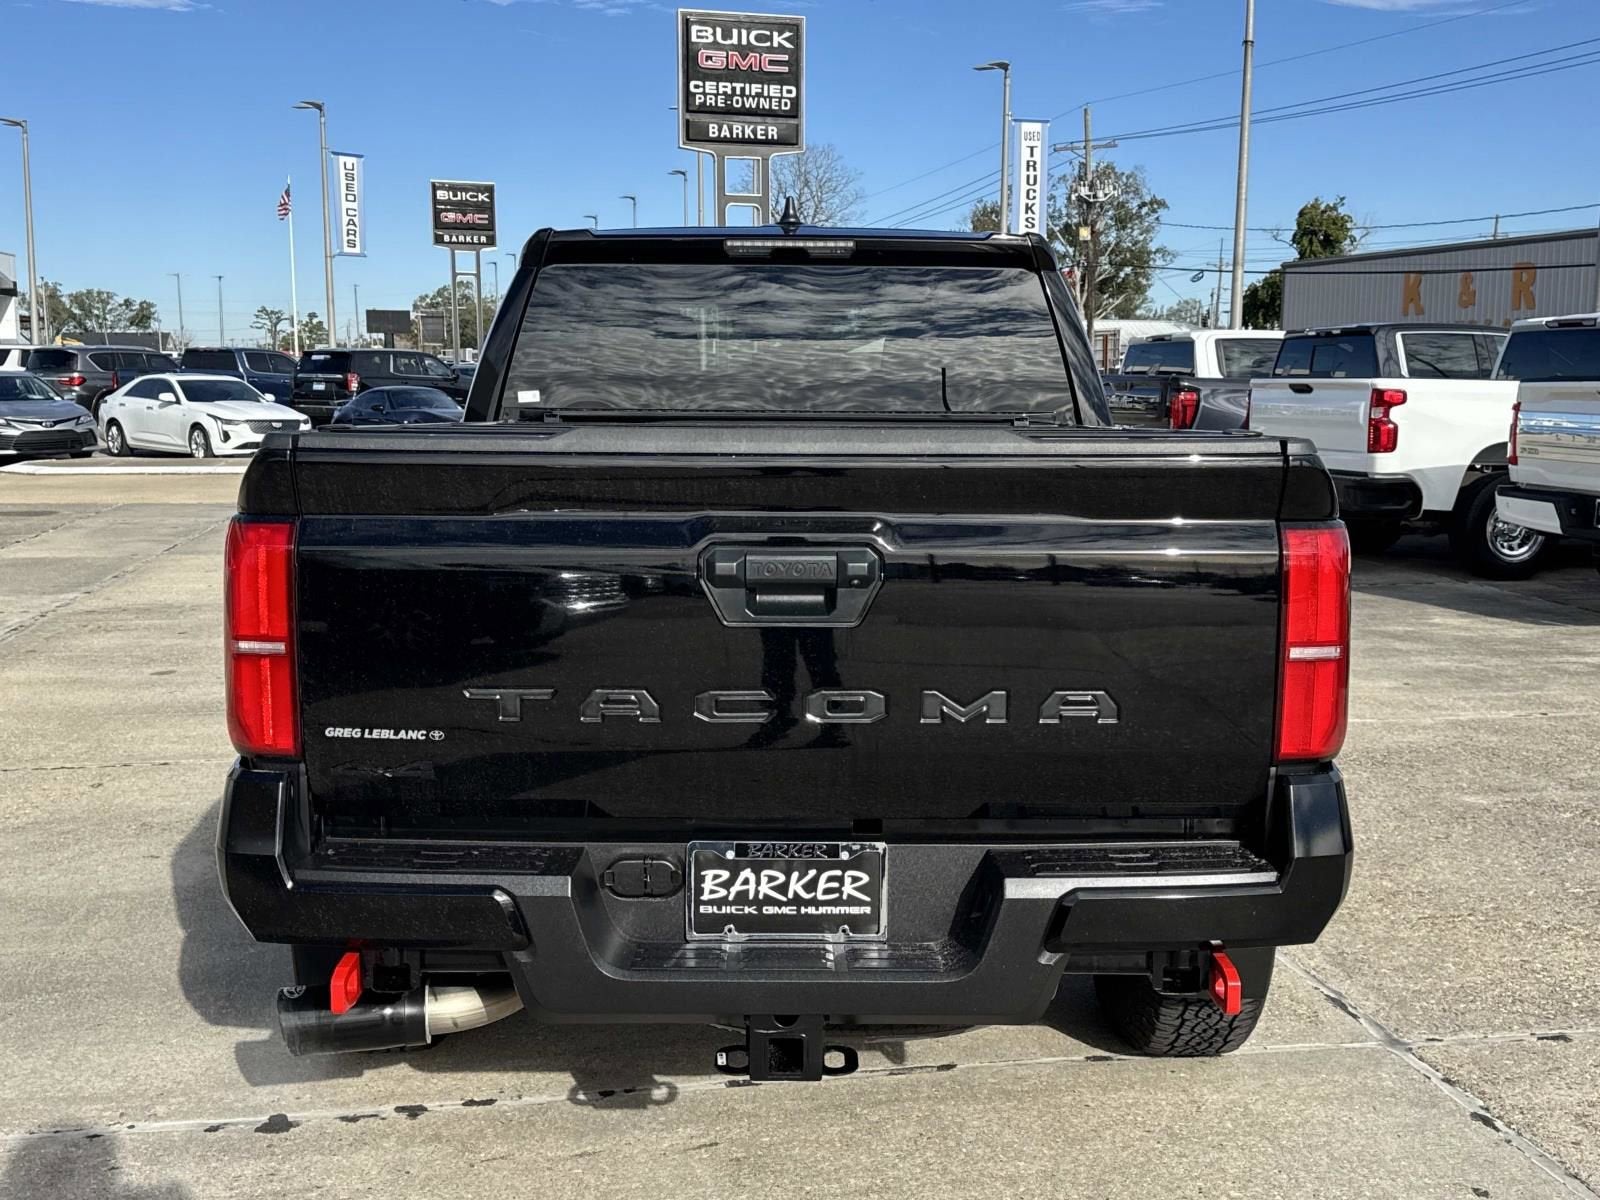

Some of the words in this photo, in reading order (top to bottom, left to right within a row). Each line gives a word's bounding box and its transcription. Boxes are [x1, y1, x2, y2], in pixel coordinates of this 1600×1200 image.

[691, 25, 795, 49] BUICK
[698, 49, 789, 72] GMC
[689, 80, 797, 98] CERTIFIED
[695, 94, 791, 110] PRE-OWNED
[708, 123, 778, 140] BARKER
[1023, 131, 1041, 141] USED
[343, 161, 357, 203] USED
[1024, 145, 1038, 229] TRUCKS
[436, 190, 490, 202] BUICK
[440, 212, 489, 224] GMC
[345, 207, 358, 248] CARS
[443, 234, 487, 243] BARKER
[1402, 271, 1424, 317] K
[1511, 262, 1537, 311] R
[751, 561, 833, 577] TOYOTA
[462, 687, 1119, 723] TACOMA
[325, 727, 362, 738] GREG
[364, 728, 427, 740] LEBLANC
[747, 843, 829, 859] BARKER
[700, 868, 871, 902] BARKER
[700, 905, 758, 914] BUICK
[762, 905, 797, 915] GMC
[801, 906, 871, 915] HUMMER
